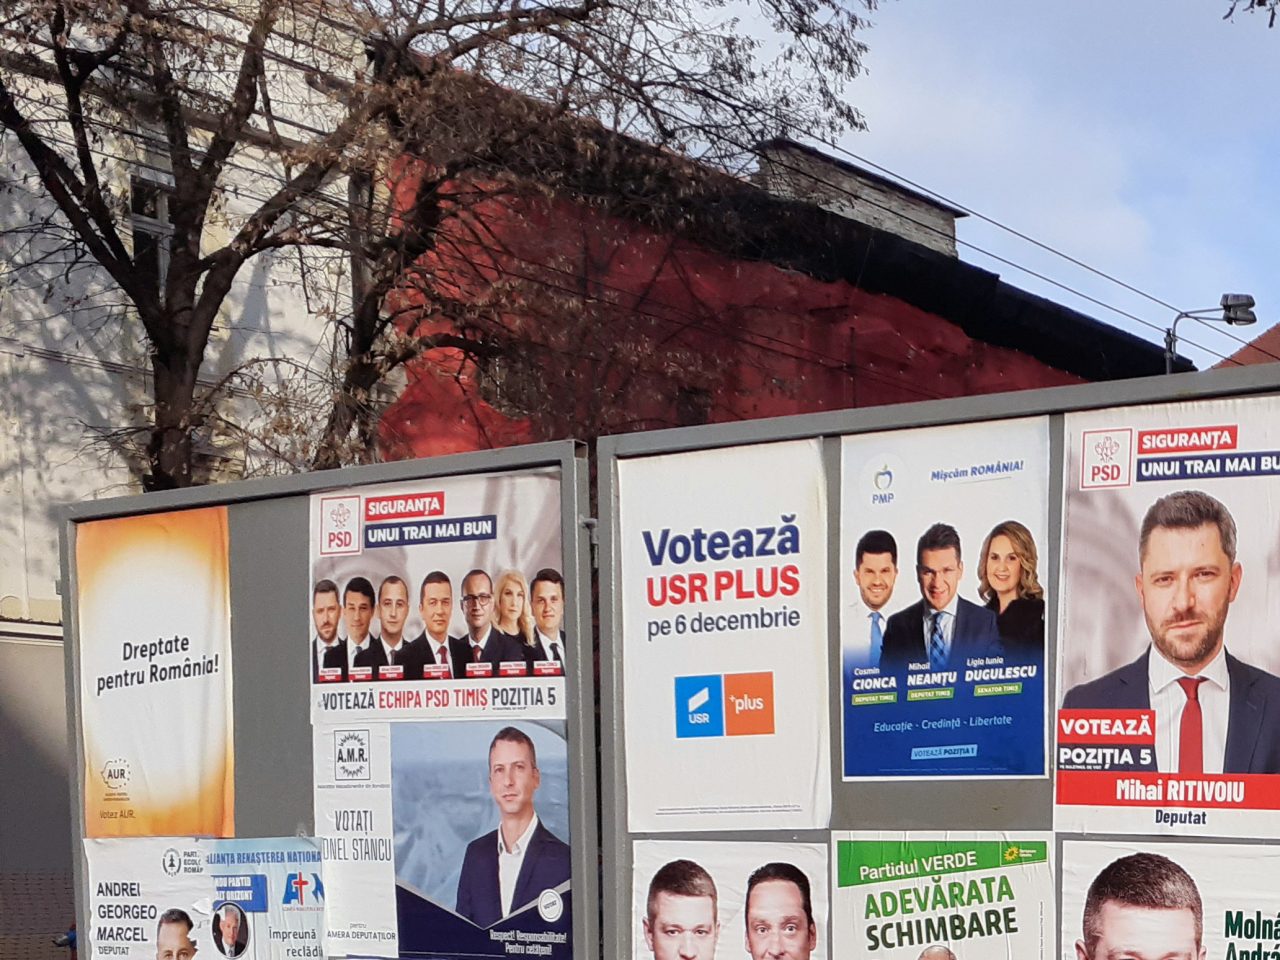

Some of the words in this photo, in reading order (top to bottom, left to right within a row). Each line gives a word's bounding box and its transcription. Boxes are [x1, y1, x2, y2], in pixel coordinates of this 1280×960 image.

[1142, 431, 1232, 454] SIGURANȚA
[1091, 465, 1121, 482] PSD
[1141, 460, 1180, 477] UNUI
[1184, 459, 1220, 475] TRAI
[1225, 458, 1255, 472] MAI
[368, 497, 440, 515] SIGURANȚA
[872, 493, 894, 504] PMP
[328, 531, 351, 548] PSD
[368, 527, 399, 542] UNUI
[403, 524, 432, 540] TRAI
[435, 524, 460, 537] MAI
[464, 521, 491, 535] BUN
[642, 514, 800, 566] Votează
[646, 572, 708, 607] USR
[714, 564, 800, 601] PLUS
[648, 618, 671, 641] pe
[675, 614, 686, 634] 6
[690, 606, 800, 634] decembrie
[122, 635, 189, 662] Dreptate
[97, 669, 144, 696] pentru
[150, 654, 219, 683] România!
[907, 672, 957, 686] NEAMȚU
[965, 666, 1037, 682] DUGULESCU
[853, 677, 896, 690] CIONCA
[689, 713, 709, 724] USR
[1060, 714, 1152, 735] VOTEAZĂ
[1060, 748, 1134, 769] POZIȚIA
[1140, 749, 1151, 765] 5
[107, 769, 126, 779] AUR
[1116, 780, 1162, 801] Mihai
[1167, 780, 1244, 803] RITIVOIU
[1155, 808, 1207, 826] Deputat
[860, 858, 918, 880] Partidul
[921, 851, 977, 871] VERDE
[97, 882, 140, 897] ANDREI
[864, 876, 1015, 919] ADEVĂRATA
[98, 904, 157, 919] GEORGEO
[97, 926, 148, 941] MARCEL
[866, 907, 1019, 951] SCHIMBARE
[98, 946, 129, 955] DEPUTAT
